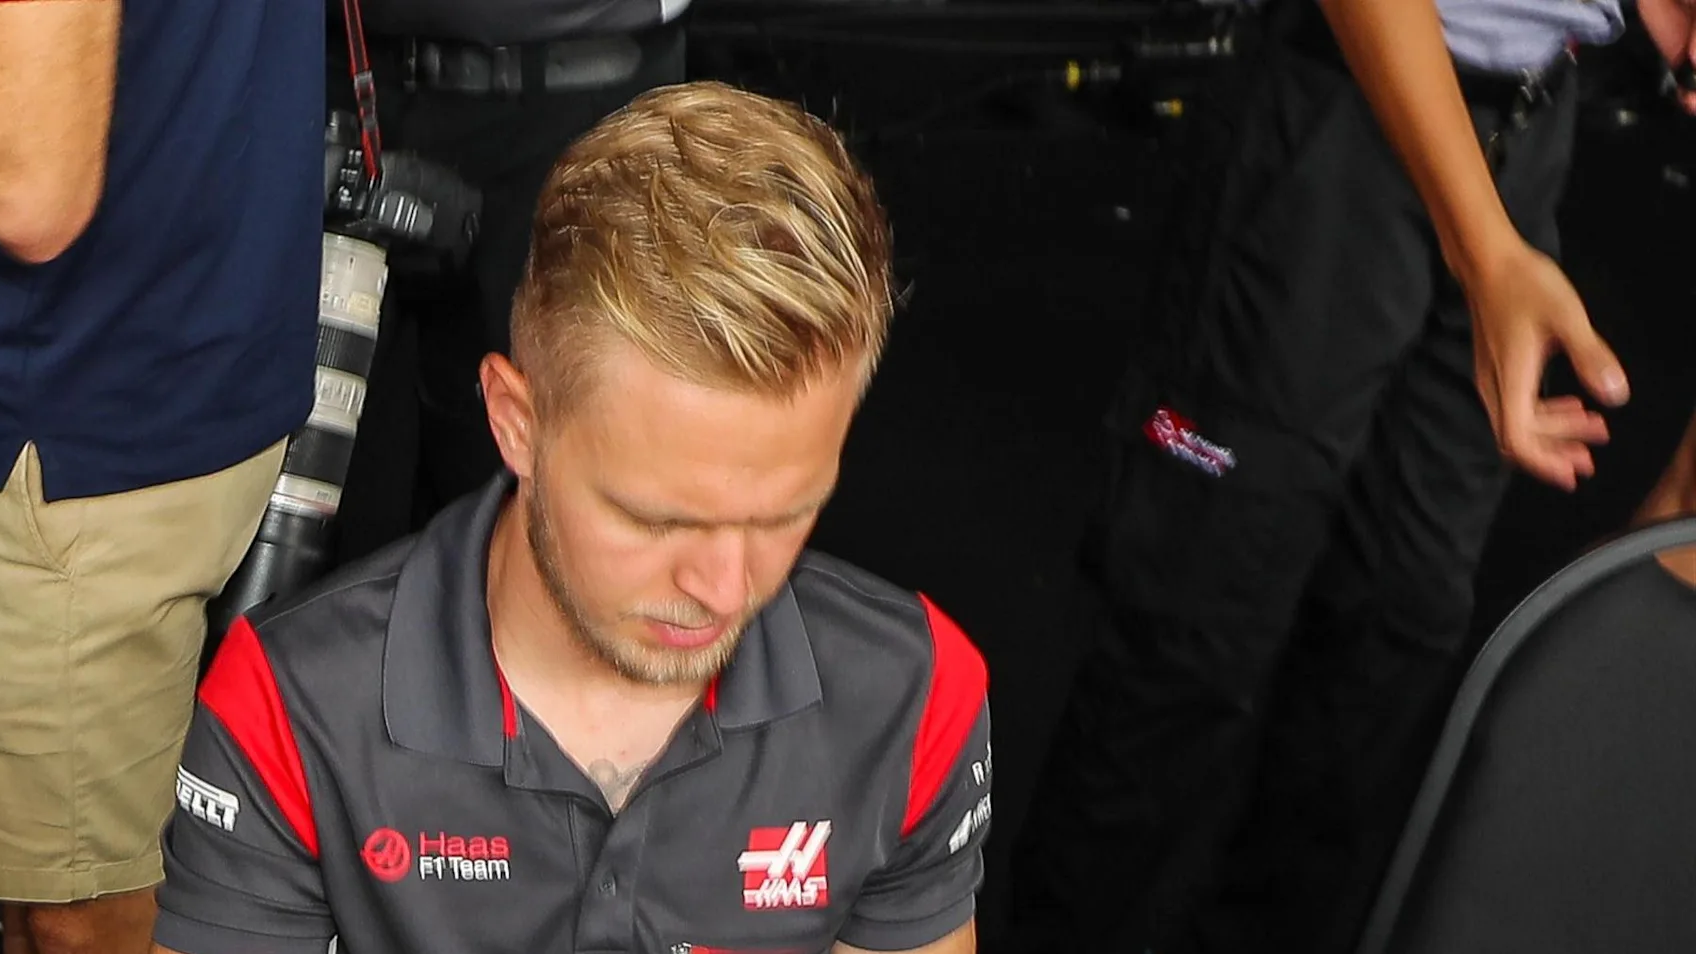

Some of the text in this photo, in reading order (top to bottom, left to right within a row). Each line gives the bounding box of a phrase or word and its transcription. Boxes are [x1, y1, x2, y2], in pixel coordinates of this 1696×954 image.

[419, 831, 510, 858] Haas
[419, 856, 510, 880] F1 Team
[743, 877, 827, 908] HAAS
